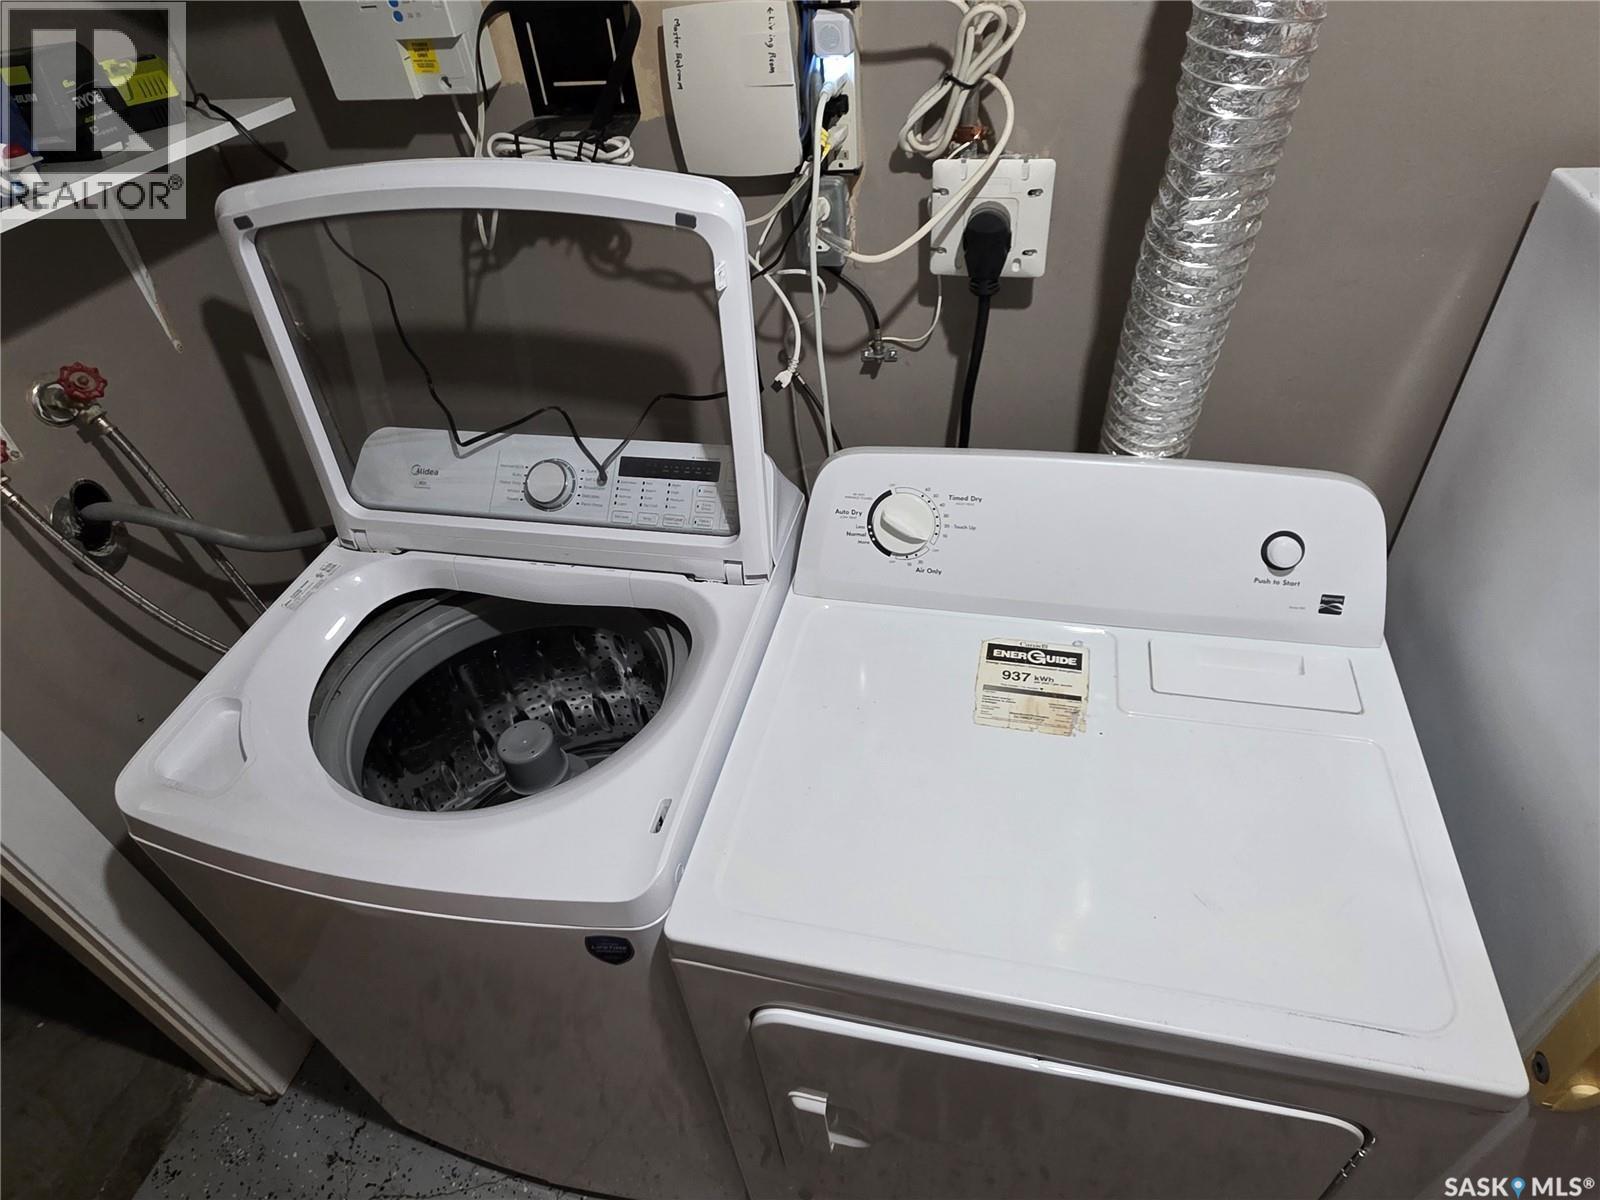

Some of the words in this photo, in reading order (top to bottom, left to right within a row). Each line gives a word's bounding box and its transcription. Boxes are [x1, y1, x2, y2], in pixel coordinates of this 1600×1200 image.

[673, 18, 682, 49] Master
[768, 52, 777, 74] Room
[675, 52, 684, 90] Bedroom
[411, 464, 439, 476] Midea
[949, 494, 969, 502] Timed
[970, 496, 983, 504] Dry
[835, 508, 850, 516] Auto
[851, 509, 863, 517] Dry
[927, 567, 942, 575] Only
[1253, 577, 1271, 585] Push
[1282, 579, 1301, 587] Start
[1002, 670, 1032, 682] 937
[1034, 675, 1055, 683] kWh
